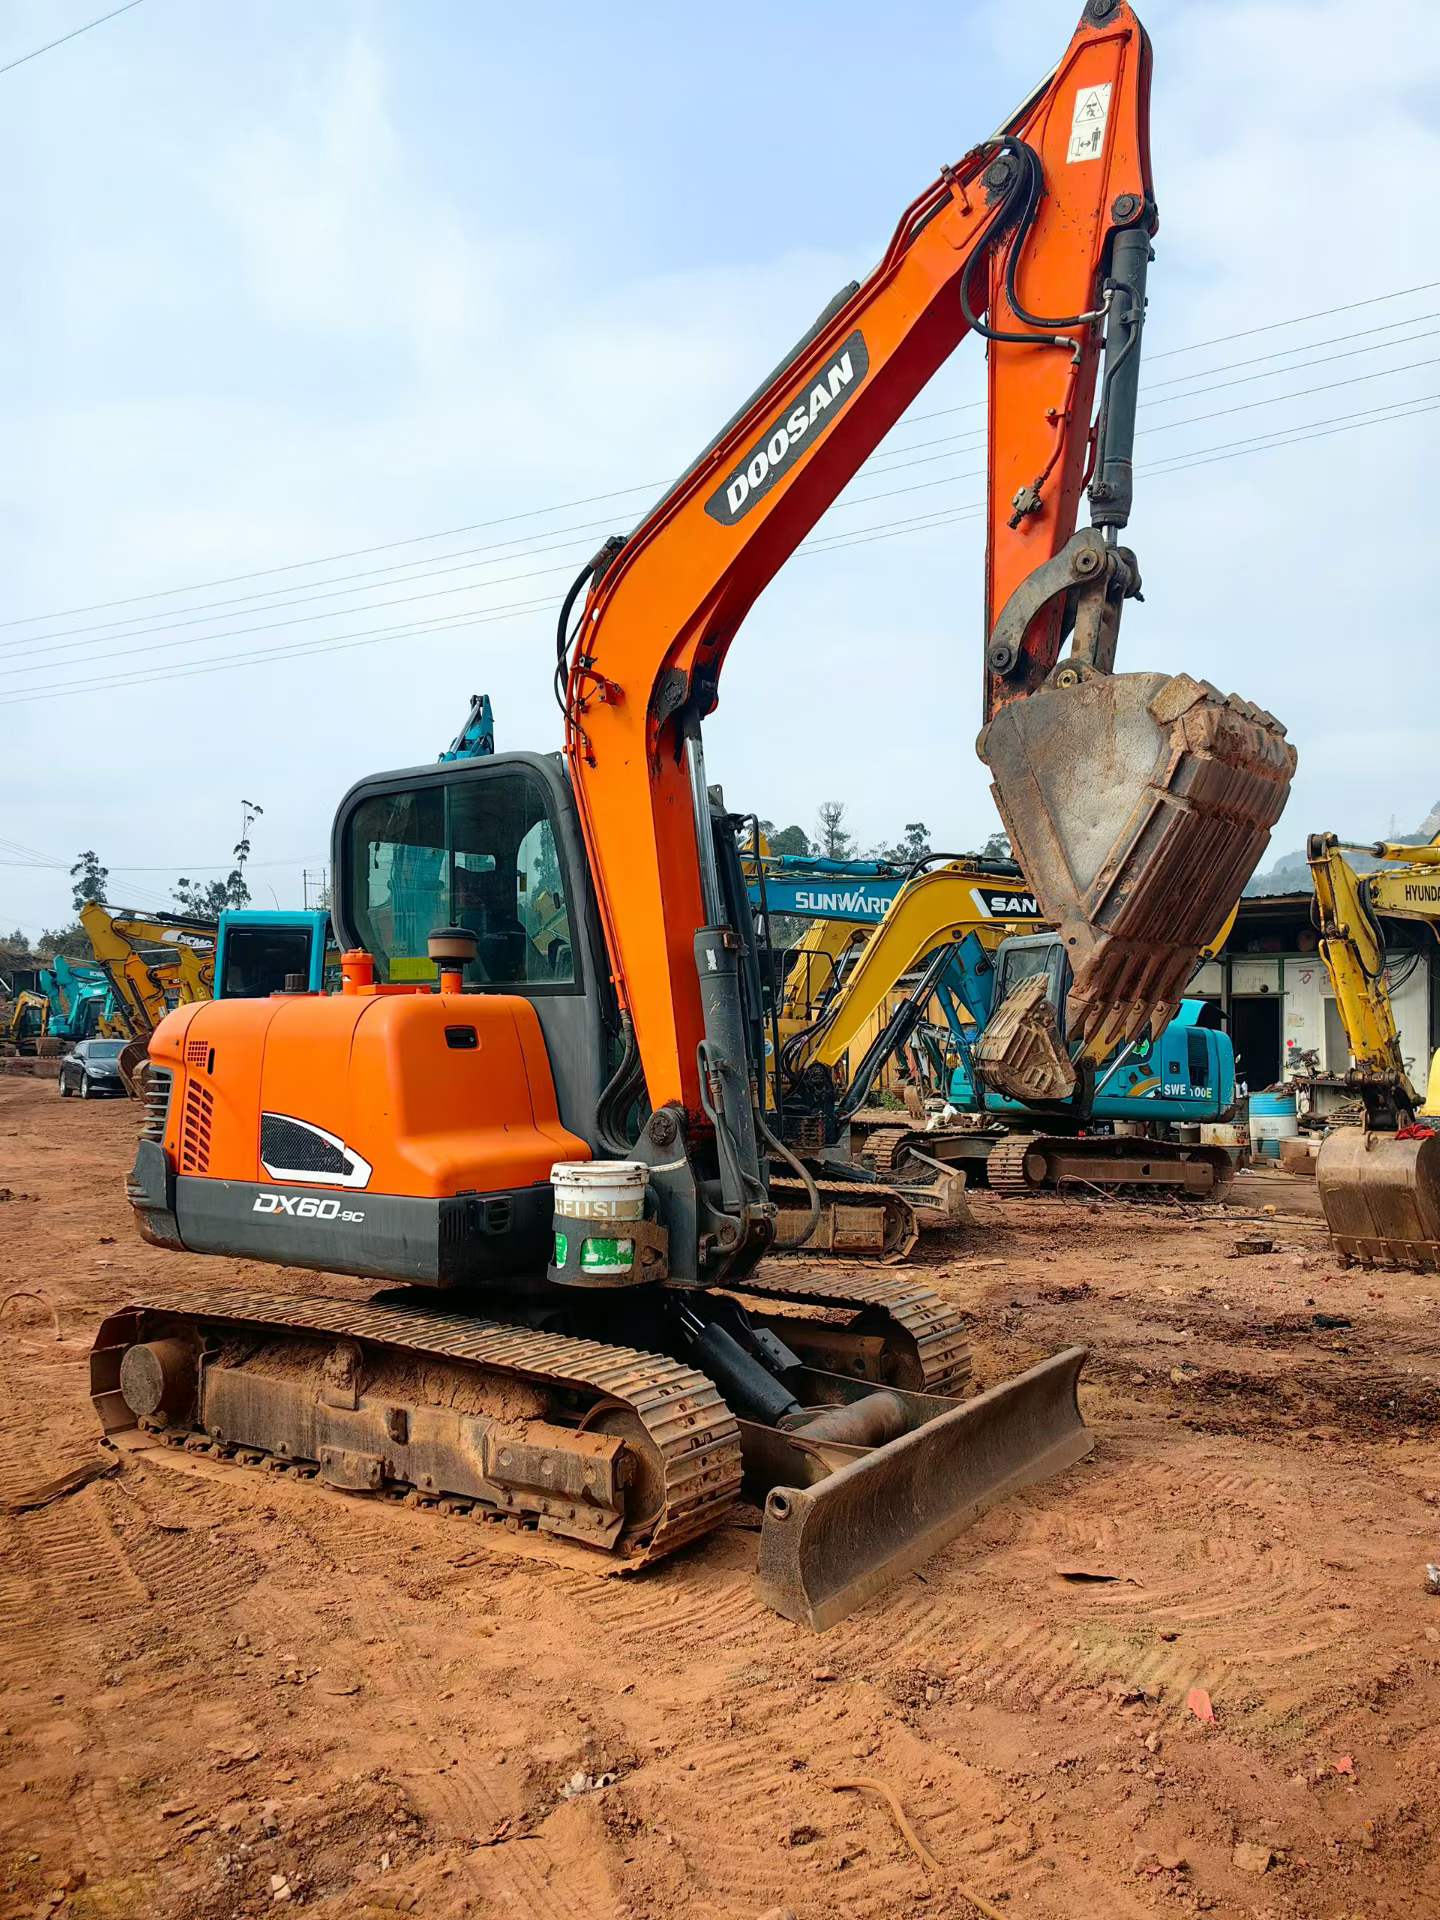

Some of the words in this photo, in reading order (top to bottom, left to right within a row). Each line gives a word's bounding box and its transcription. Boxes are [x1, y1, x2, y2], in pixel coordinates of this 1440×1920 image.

[726, 351, 855, 515] DOOSAN
[795, 886, 892, 914] SUNWARD
[991, 897, 1037, 913] SAN
[1164, 1084, 1187, 1096] SWE
[252, 1193, 366, 1223] DX60-9C
